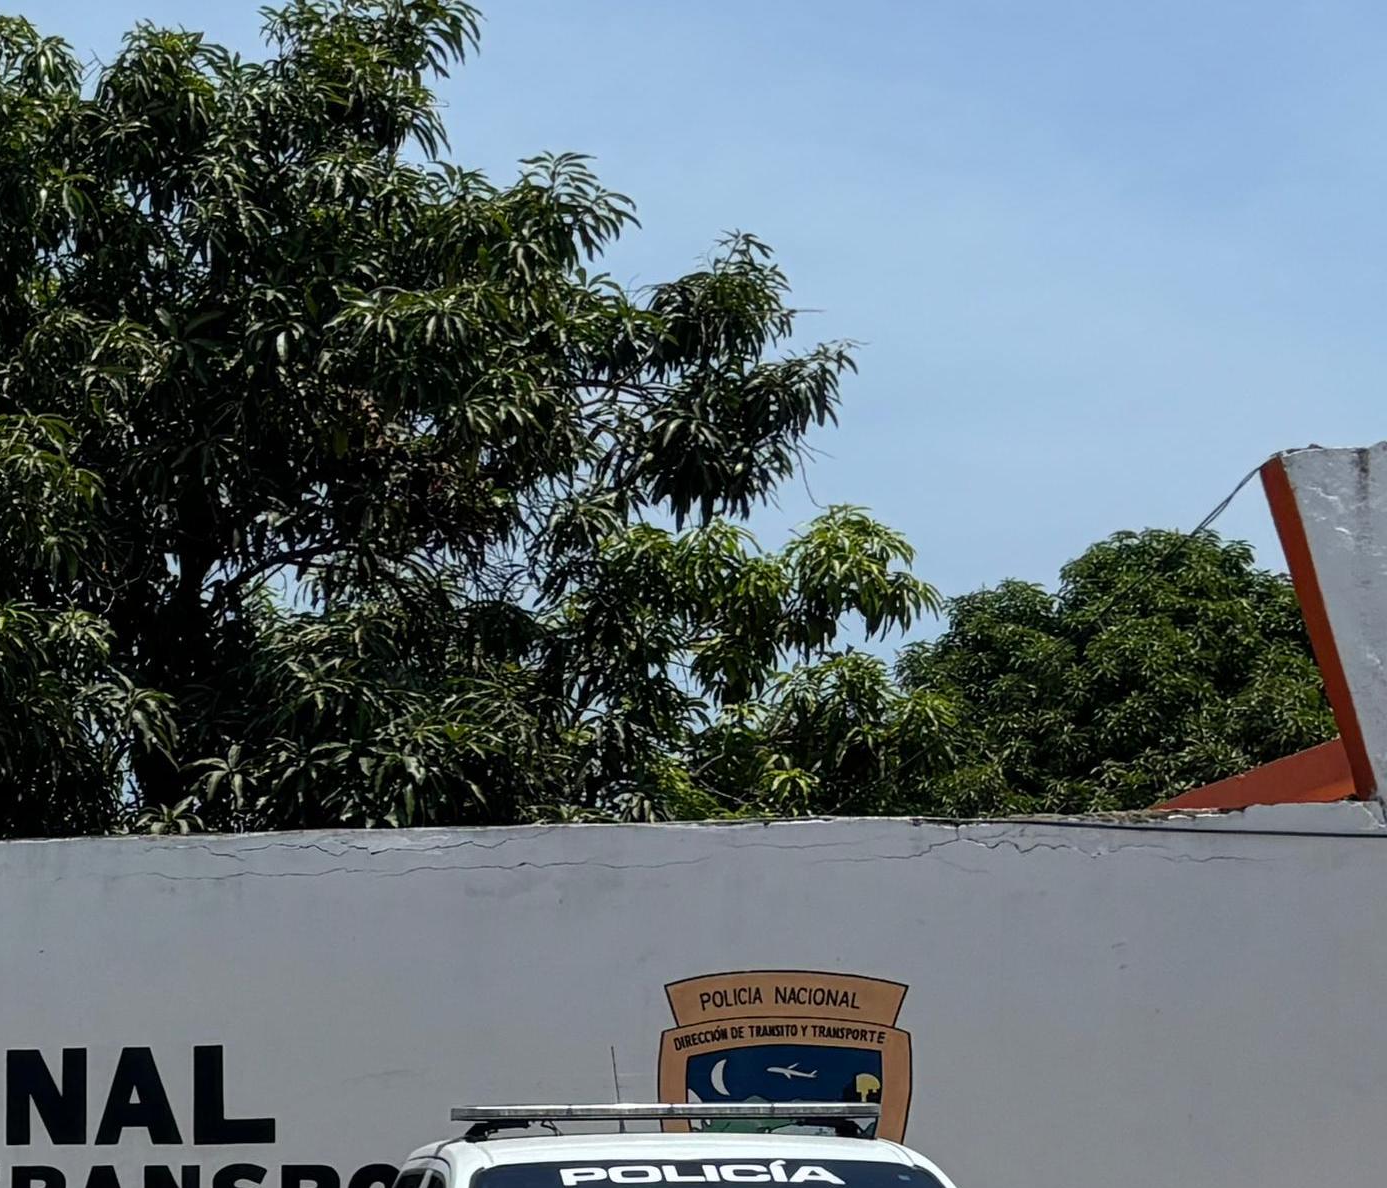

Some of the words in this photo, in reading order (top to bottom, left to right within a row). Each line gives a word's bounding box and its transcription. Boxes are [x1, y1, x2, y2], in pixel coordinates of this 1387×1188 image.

[774, 986, 860, 1009] NACIONAL
[731, 1026, 745, 1039] DE
[750, 1023, 798, 1038] TRANSITO
[801, 1026, 808, 1037] Y
[811, 1024, 886, 1044] TRANSPORTE
[559, 1159, 847, 1186] POLICÍA
